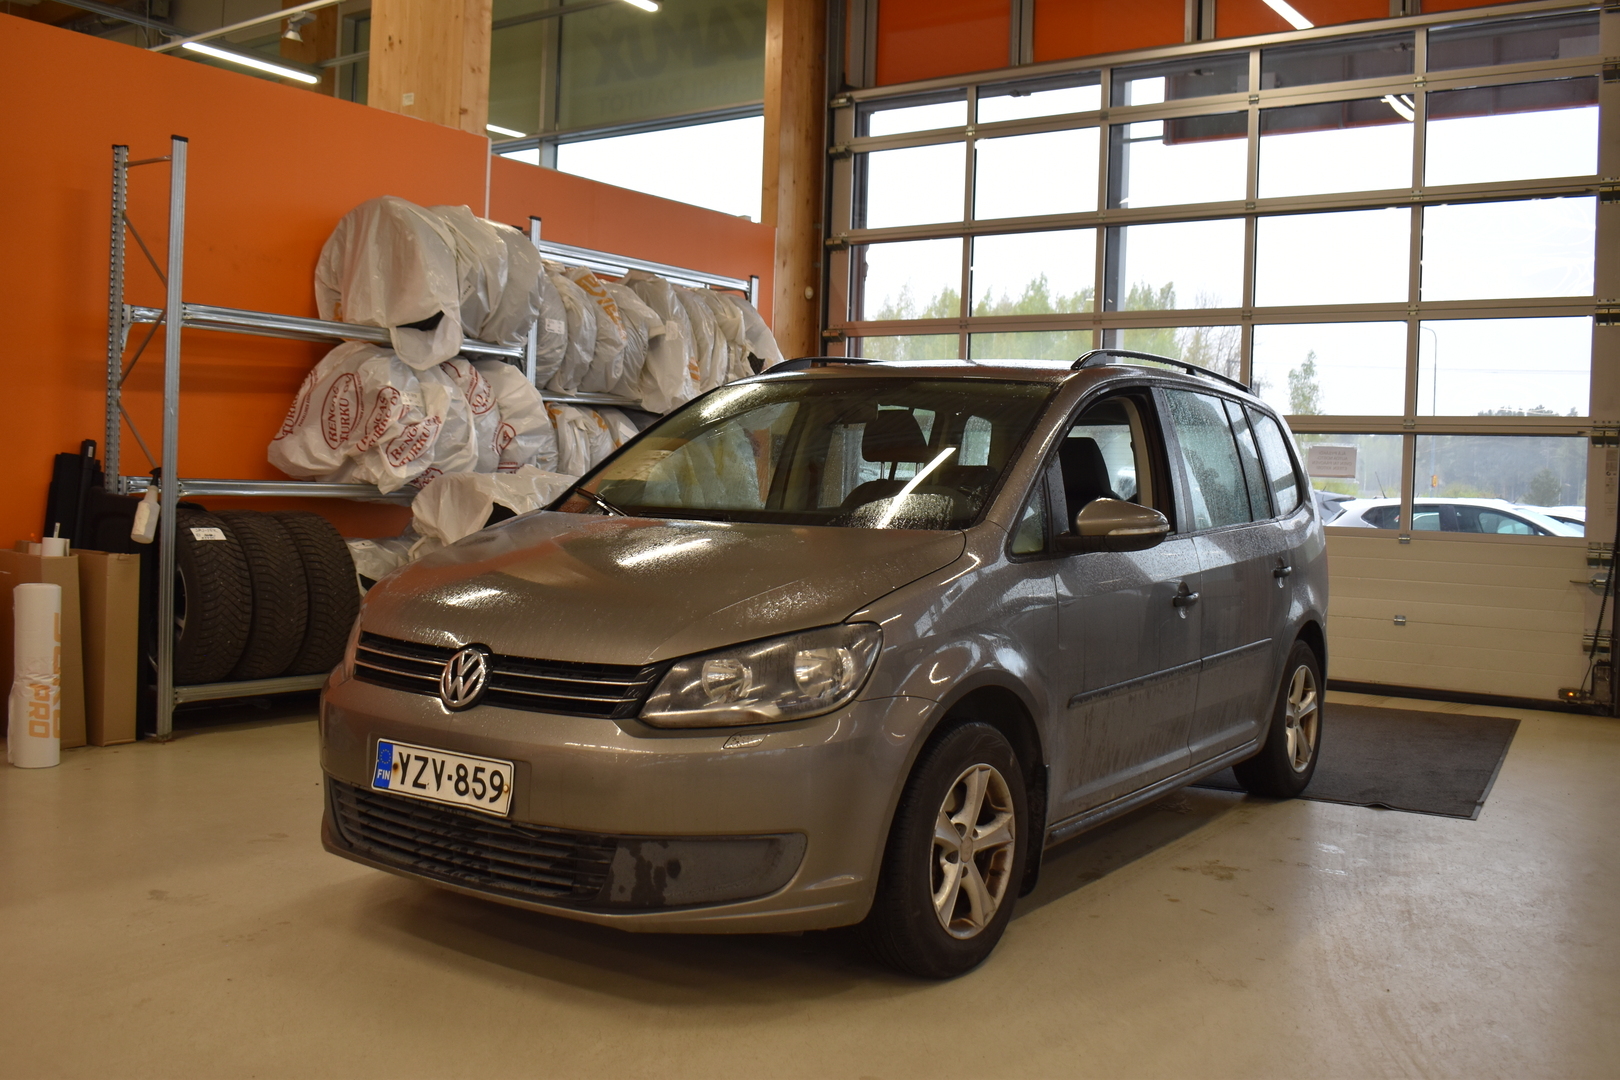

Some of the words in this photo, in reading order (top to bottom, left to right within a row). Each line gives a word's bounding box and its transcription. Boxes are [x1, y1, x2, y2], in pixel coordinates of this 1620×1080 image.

[28, 683, 50, 739] PRO
[376, 768, 390, 781] FIN
[398, 751, 505, 804] YZV-859
